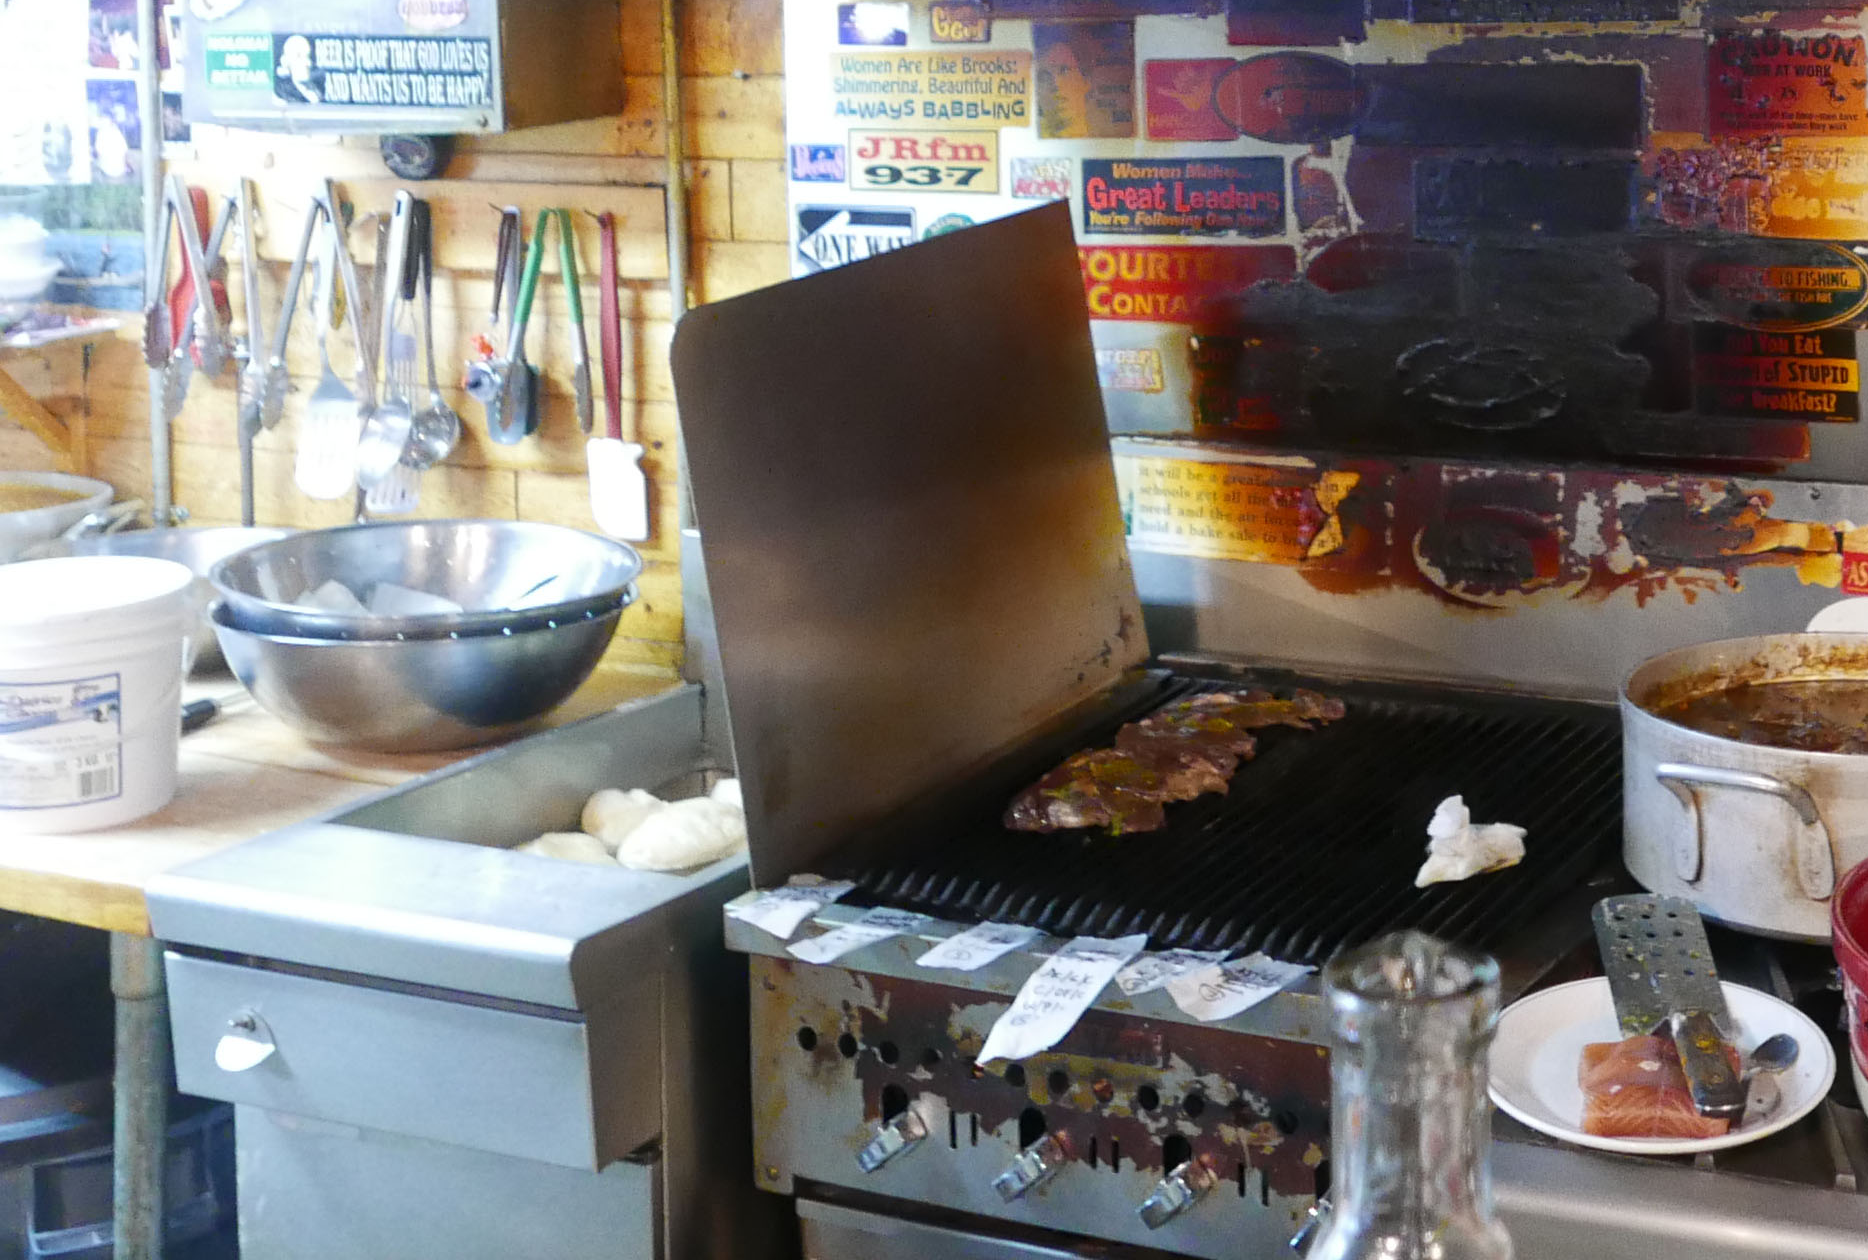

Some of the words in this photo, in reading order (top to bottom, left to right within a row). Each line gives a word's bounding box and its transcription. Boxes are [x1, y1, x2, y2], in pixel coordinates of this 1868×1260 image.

[857, 137, 991, 163] JRfm
[1087, 178, 1166, 212] Great
[1174, 182, 1281, 212] Leaders
